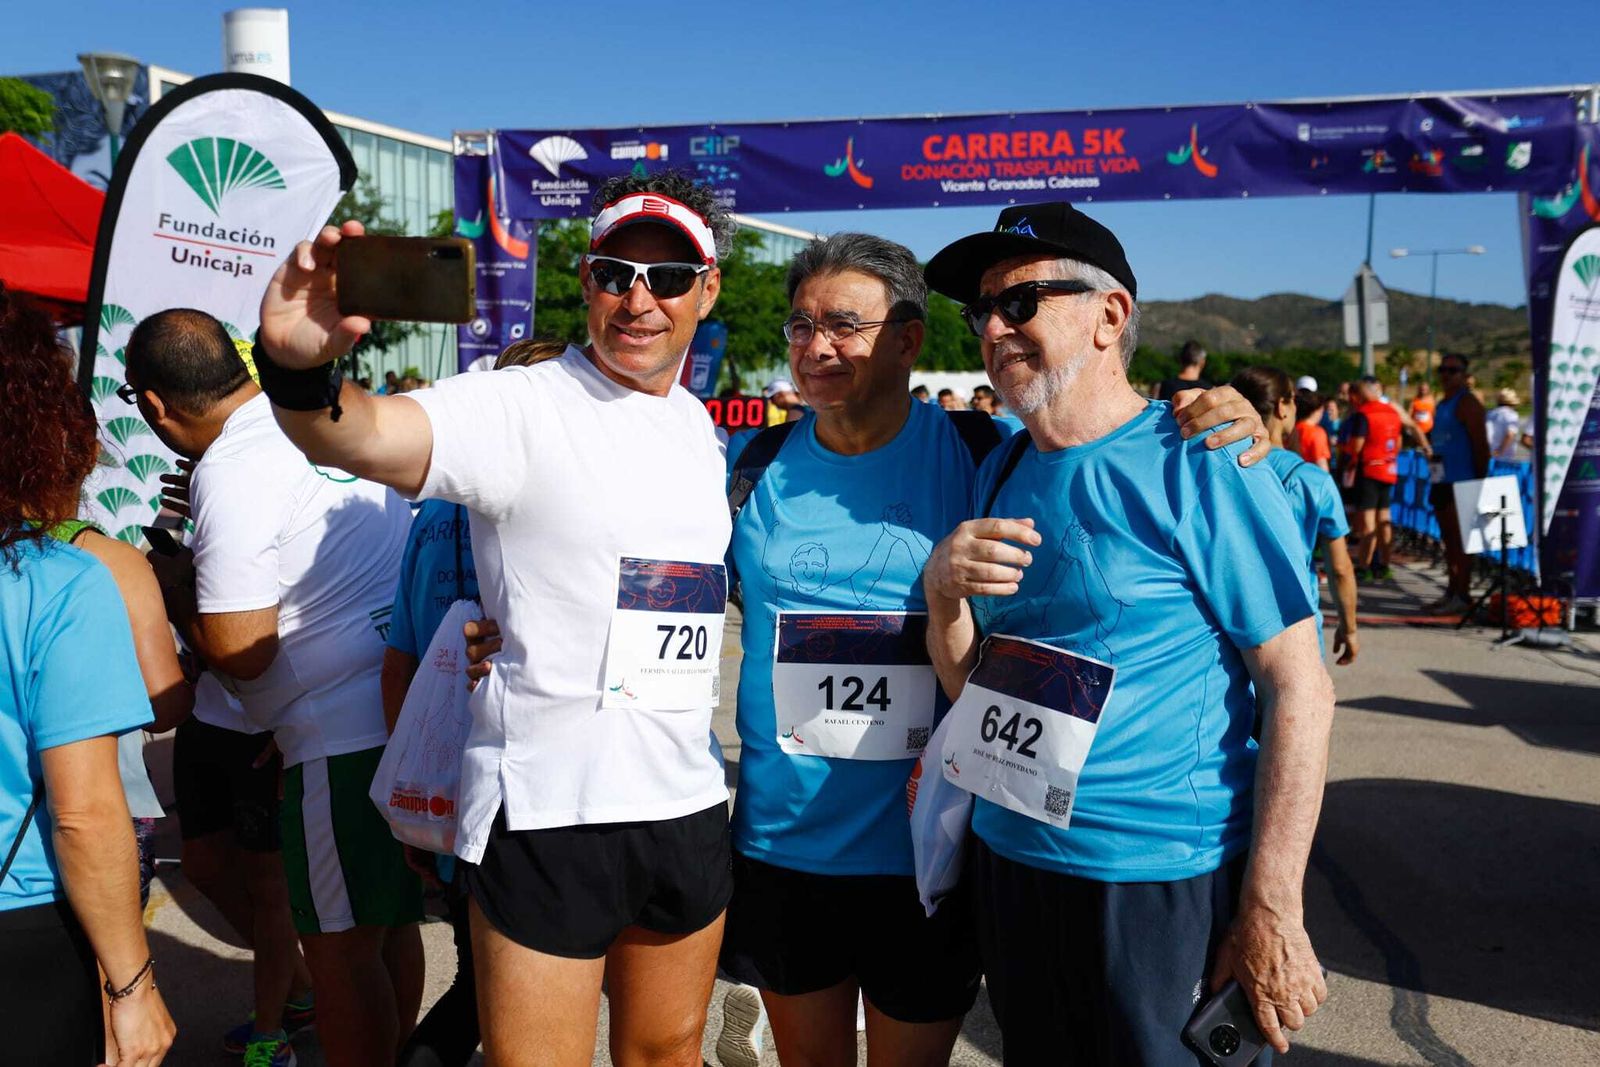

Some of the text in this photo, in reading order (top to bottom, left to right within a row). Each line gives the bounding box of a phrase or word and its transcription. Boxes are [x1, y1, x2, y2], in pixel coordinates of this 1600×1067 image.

[923, 128, 1125, 160] CARRERA 5K
[531, 178, 589, 190] Fundación
[901, 157, 1140, 180] DONACIÓN TRASPLANTE VIDA
[941, 175, 1100, 192] Vicente Granados Cabezas
[540, 194, 581, 208] Unicaja
[158, 212, 276, 248] Fundación
[171, 246, 253, 277] Unicaja
[657, 624, 708, 660] 720
[818, 675, 891, 711] 124
[824, 718, 849, 726] RAFAEL
[981, 705, 1043, 759] 642
